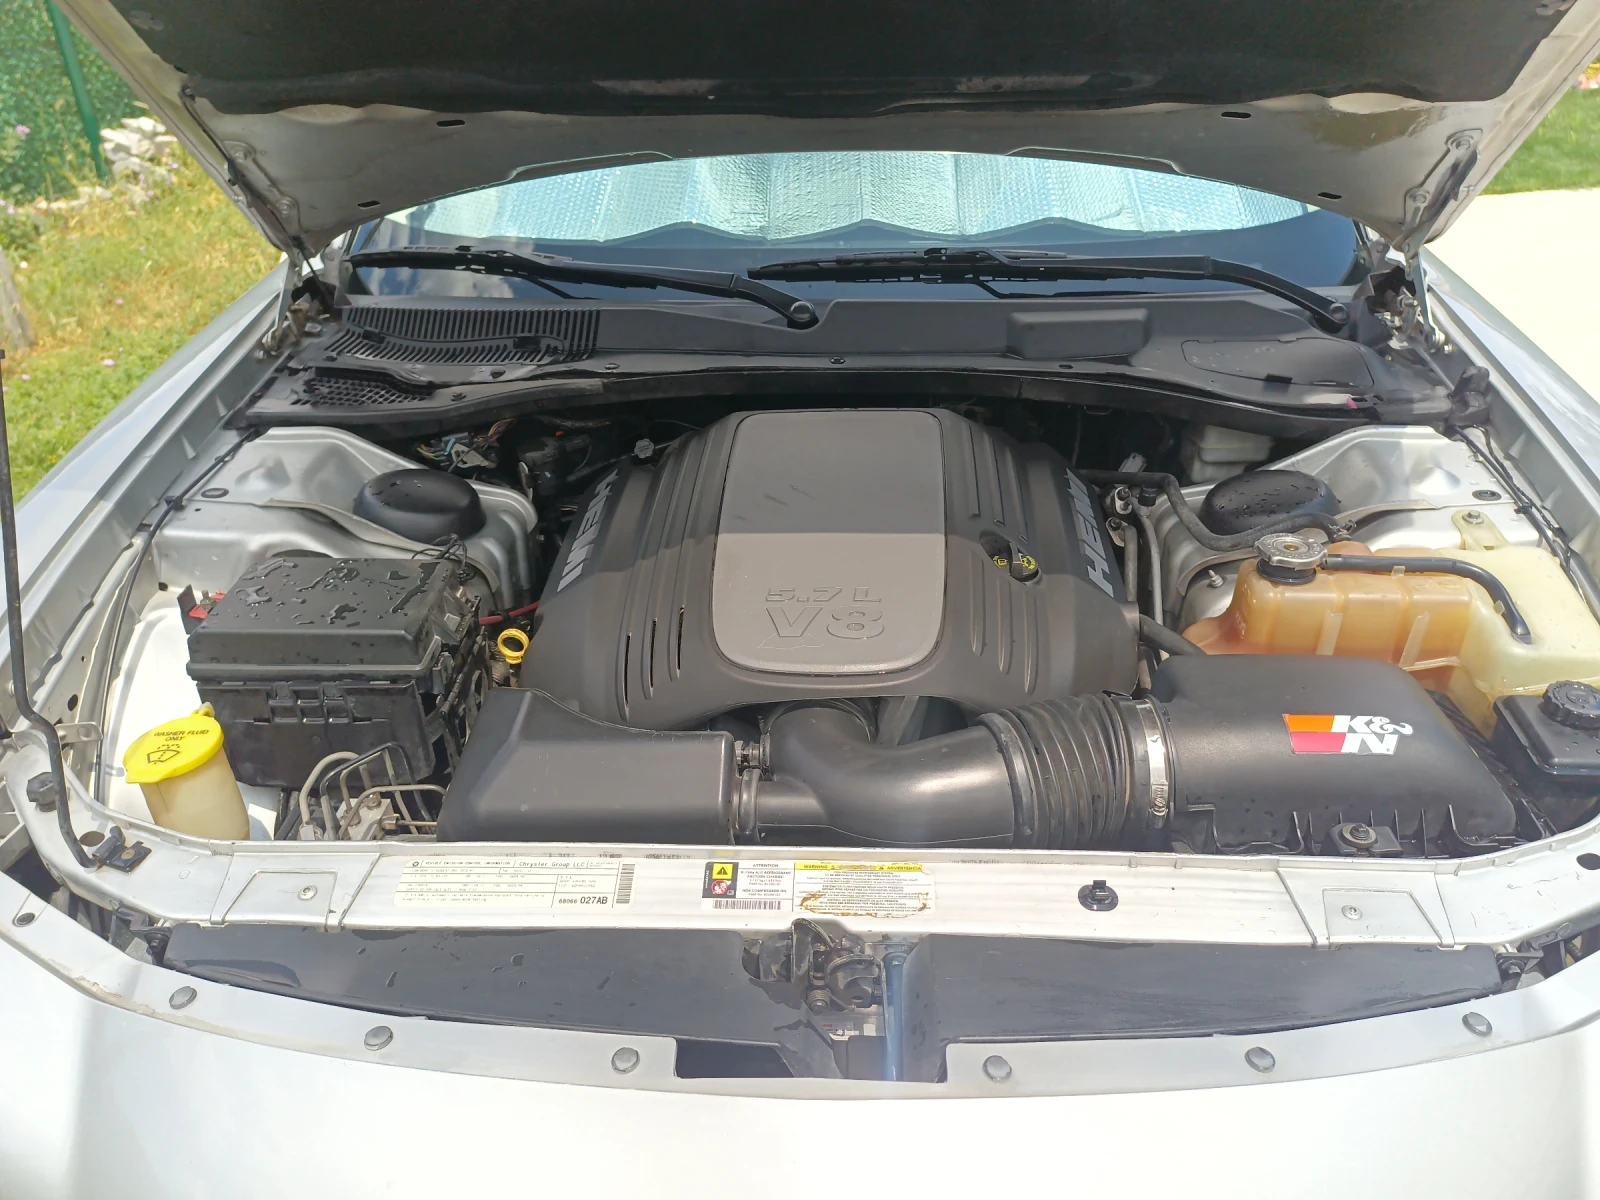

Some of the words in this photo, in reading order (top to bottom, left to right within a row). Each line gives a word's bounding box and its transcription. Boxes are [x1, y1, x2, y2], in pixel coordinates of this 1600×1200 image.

[557, 468, 619, 593] HEMI
[1064, 467, 1114, 598] HEMI
[765, 604, 885, 639] V8
[551, 861, 571, 869] Group
[580, 896, 609, 904] 027AB
